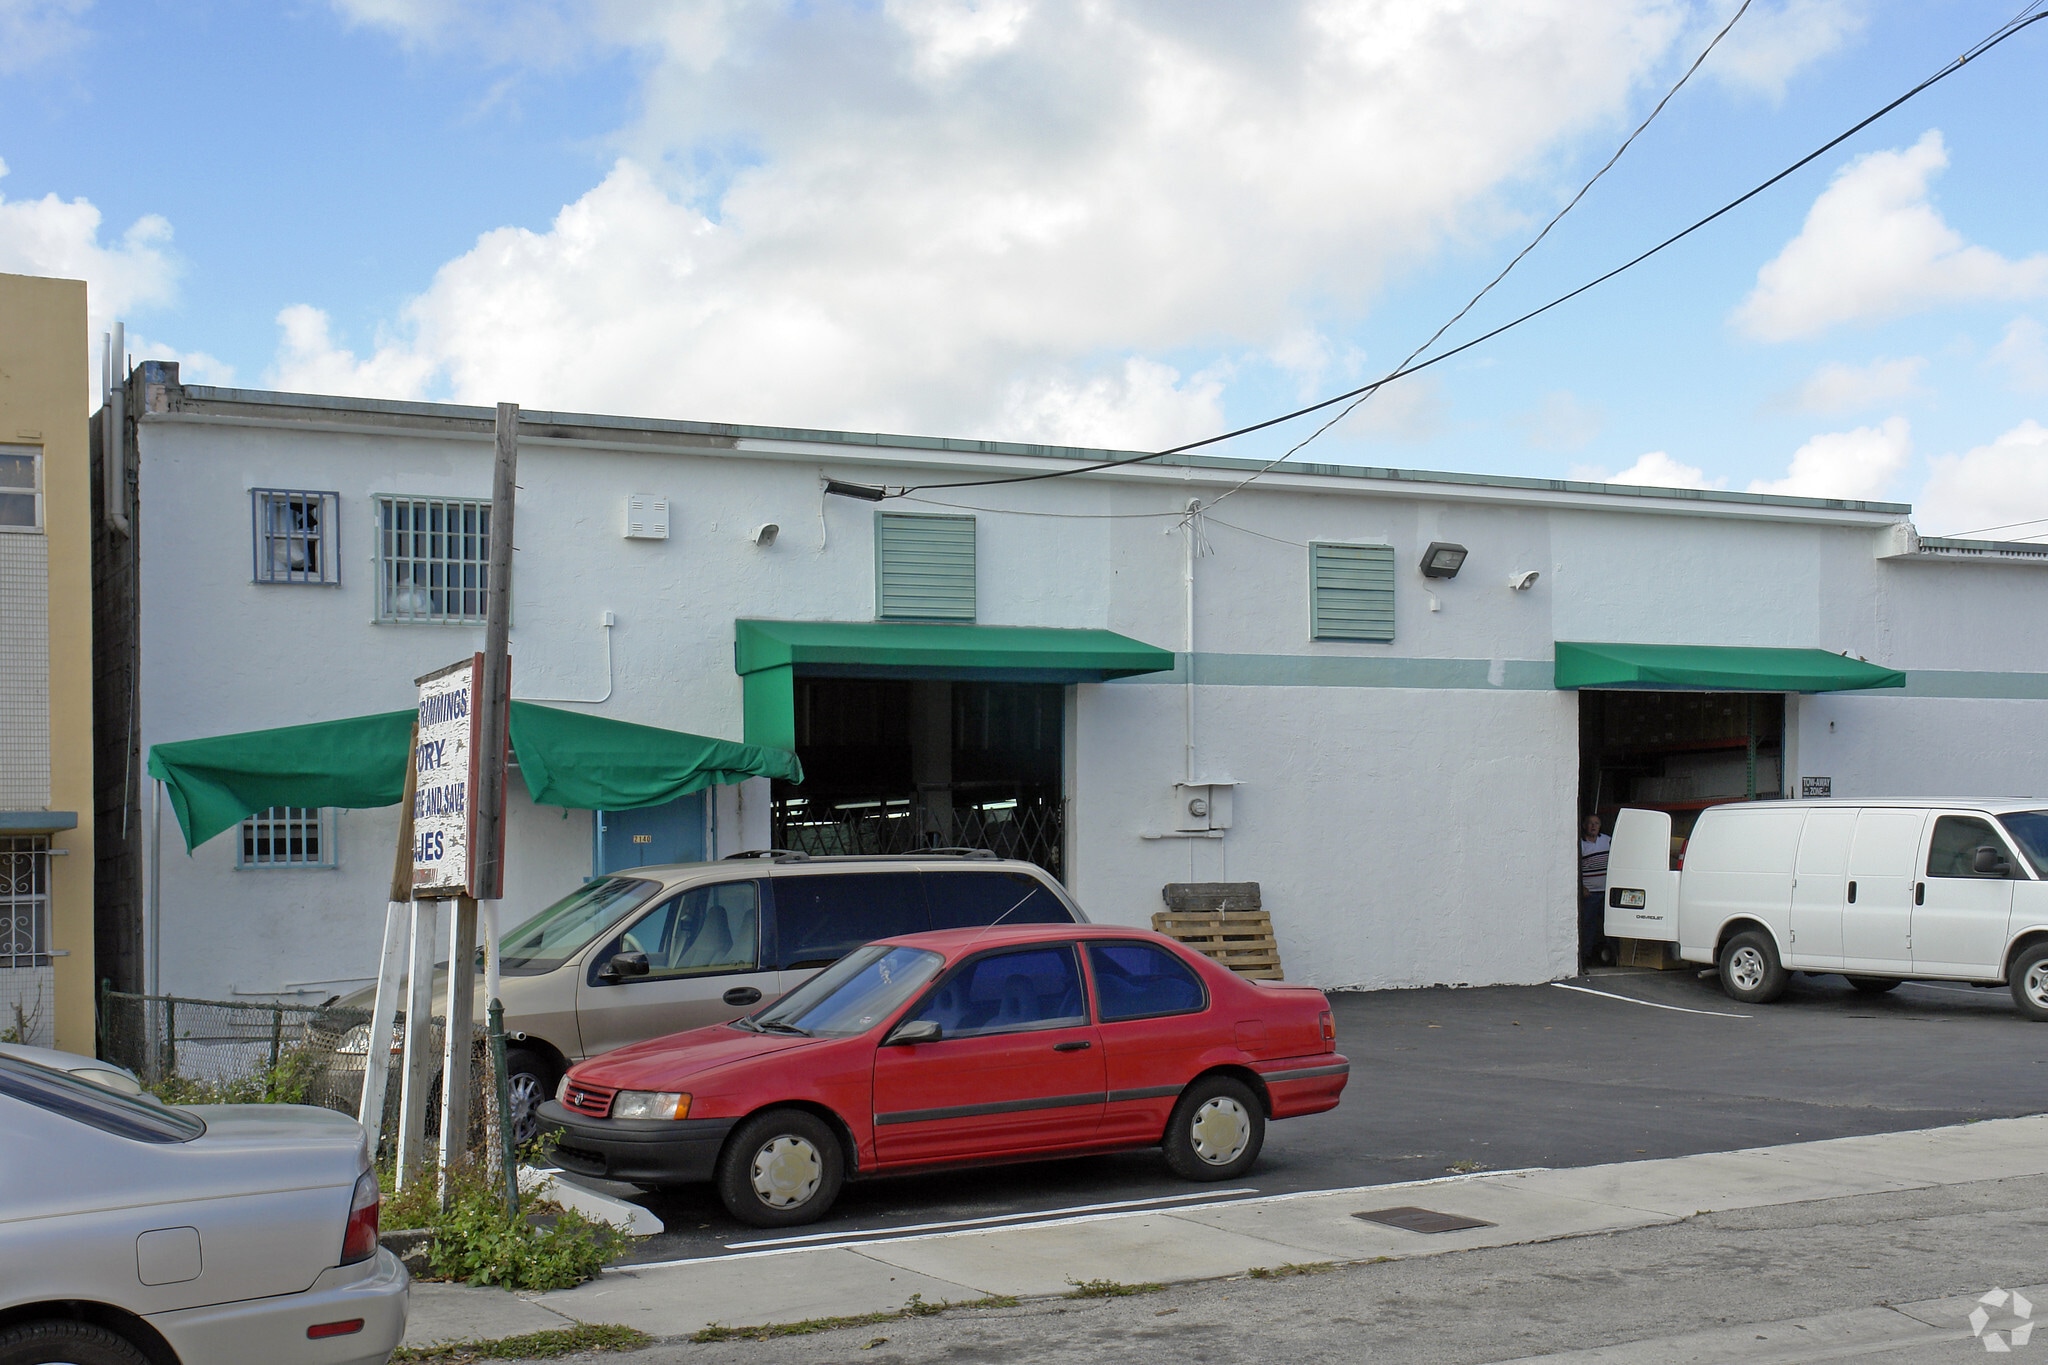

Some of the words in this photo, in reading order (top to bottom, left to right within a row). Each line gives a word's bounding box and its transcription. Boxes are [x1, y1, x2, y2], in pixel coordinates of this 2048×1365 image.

[416, 739, 446, 772] ORY
[1803, 778, 1830, 787] TOW-AWAY
[1810, 787, 1824, 796] ZONE
[426, 786, 442, 816] AND
[444, 782, 465, 813] SAVE
[634, 835, 651, 843] 2140
